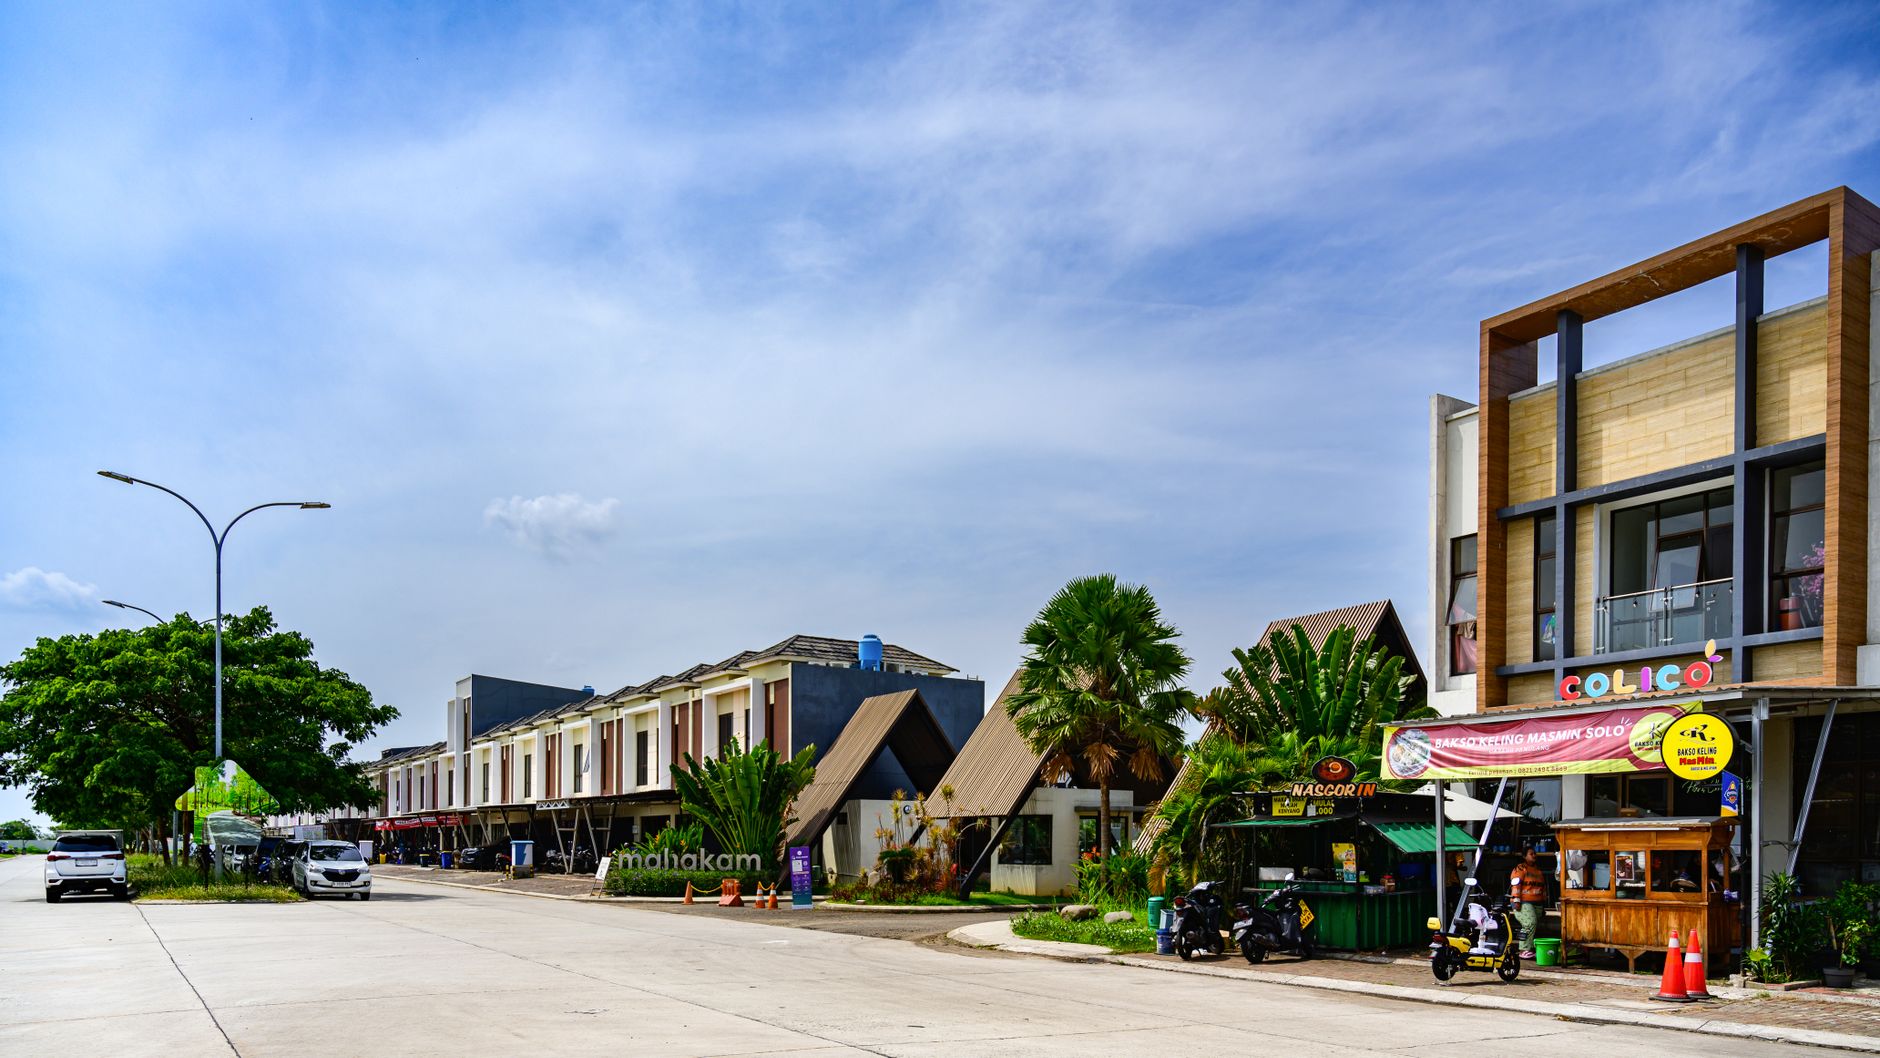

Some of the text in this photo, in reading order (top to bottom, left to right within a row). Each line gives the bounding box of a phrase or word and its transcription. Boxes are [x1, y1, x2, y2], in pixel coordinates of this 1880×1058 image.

[1559, 661, 1712, 700] COLICO
[1435, 724, 1625, 749] BAKSO KELING MASMIN SOLO
[1677, 746, 1717, 756] BAKSO KELING
[618, 847, 761, 871] mahakam
